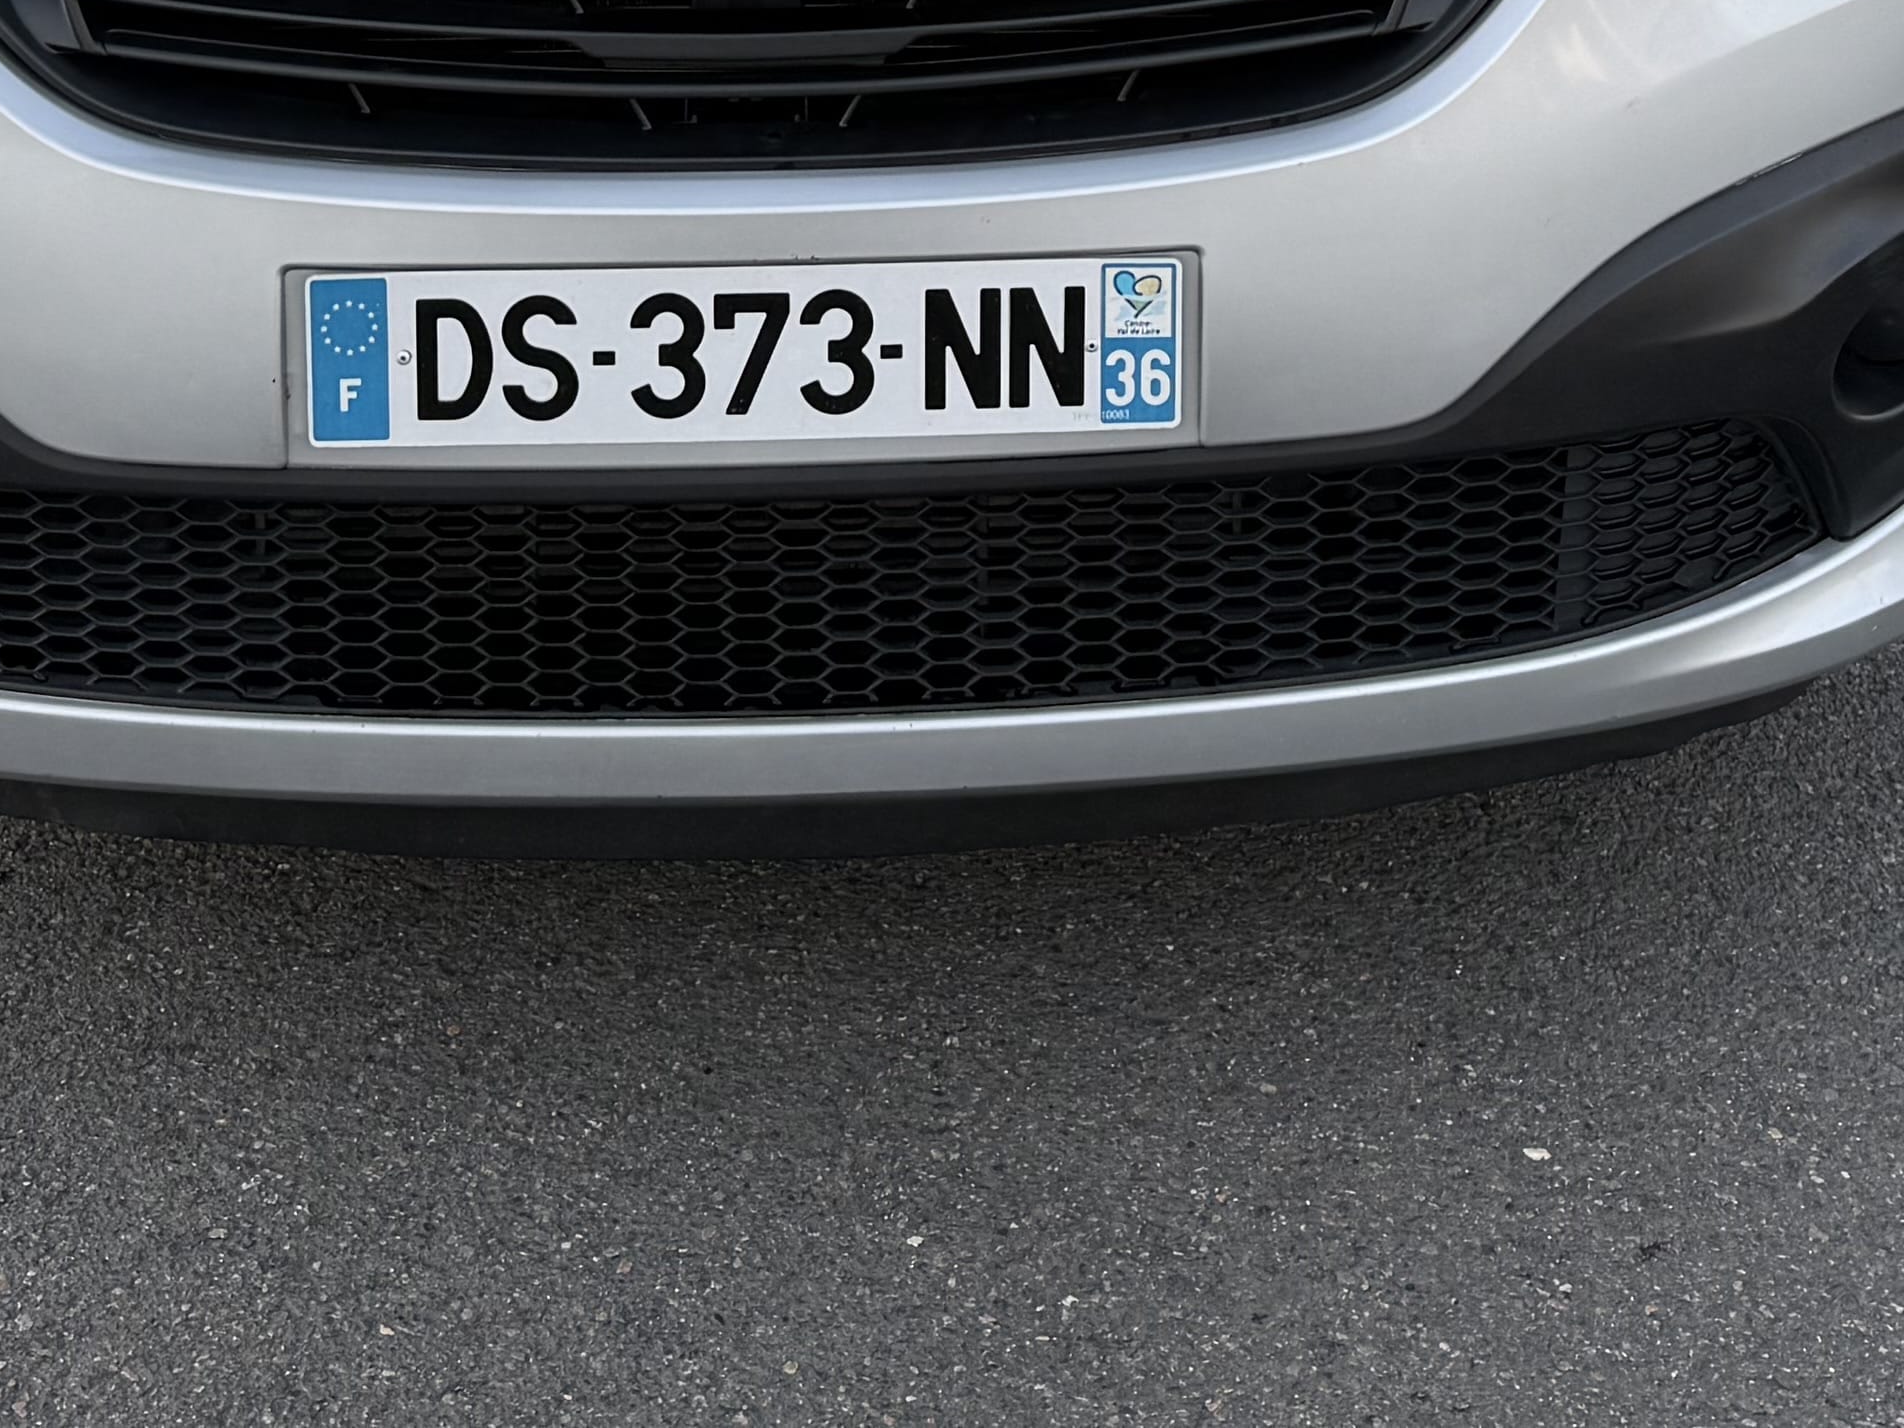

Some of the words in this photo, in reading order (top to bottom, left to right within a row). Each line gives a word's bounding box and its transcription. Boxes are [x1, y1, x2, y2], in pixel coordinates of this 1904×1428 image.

[415, 287, 1086, 422] DS-373-NN
[1105, 349, 1171, 406] 36
[339, 377, 362, 412] F
